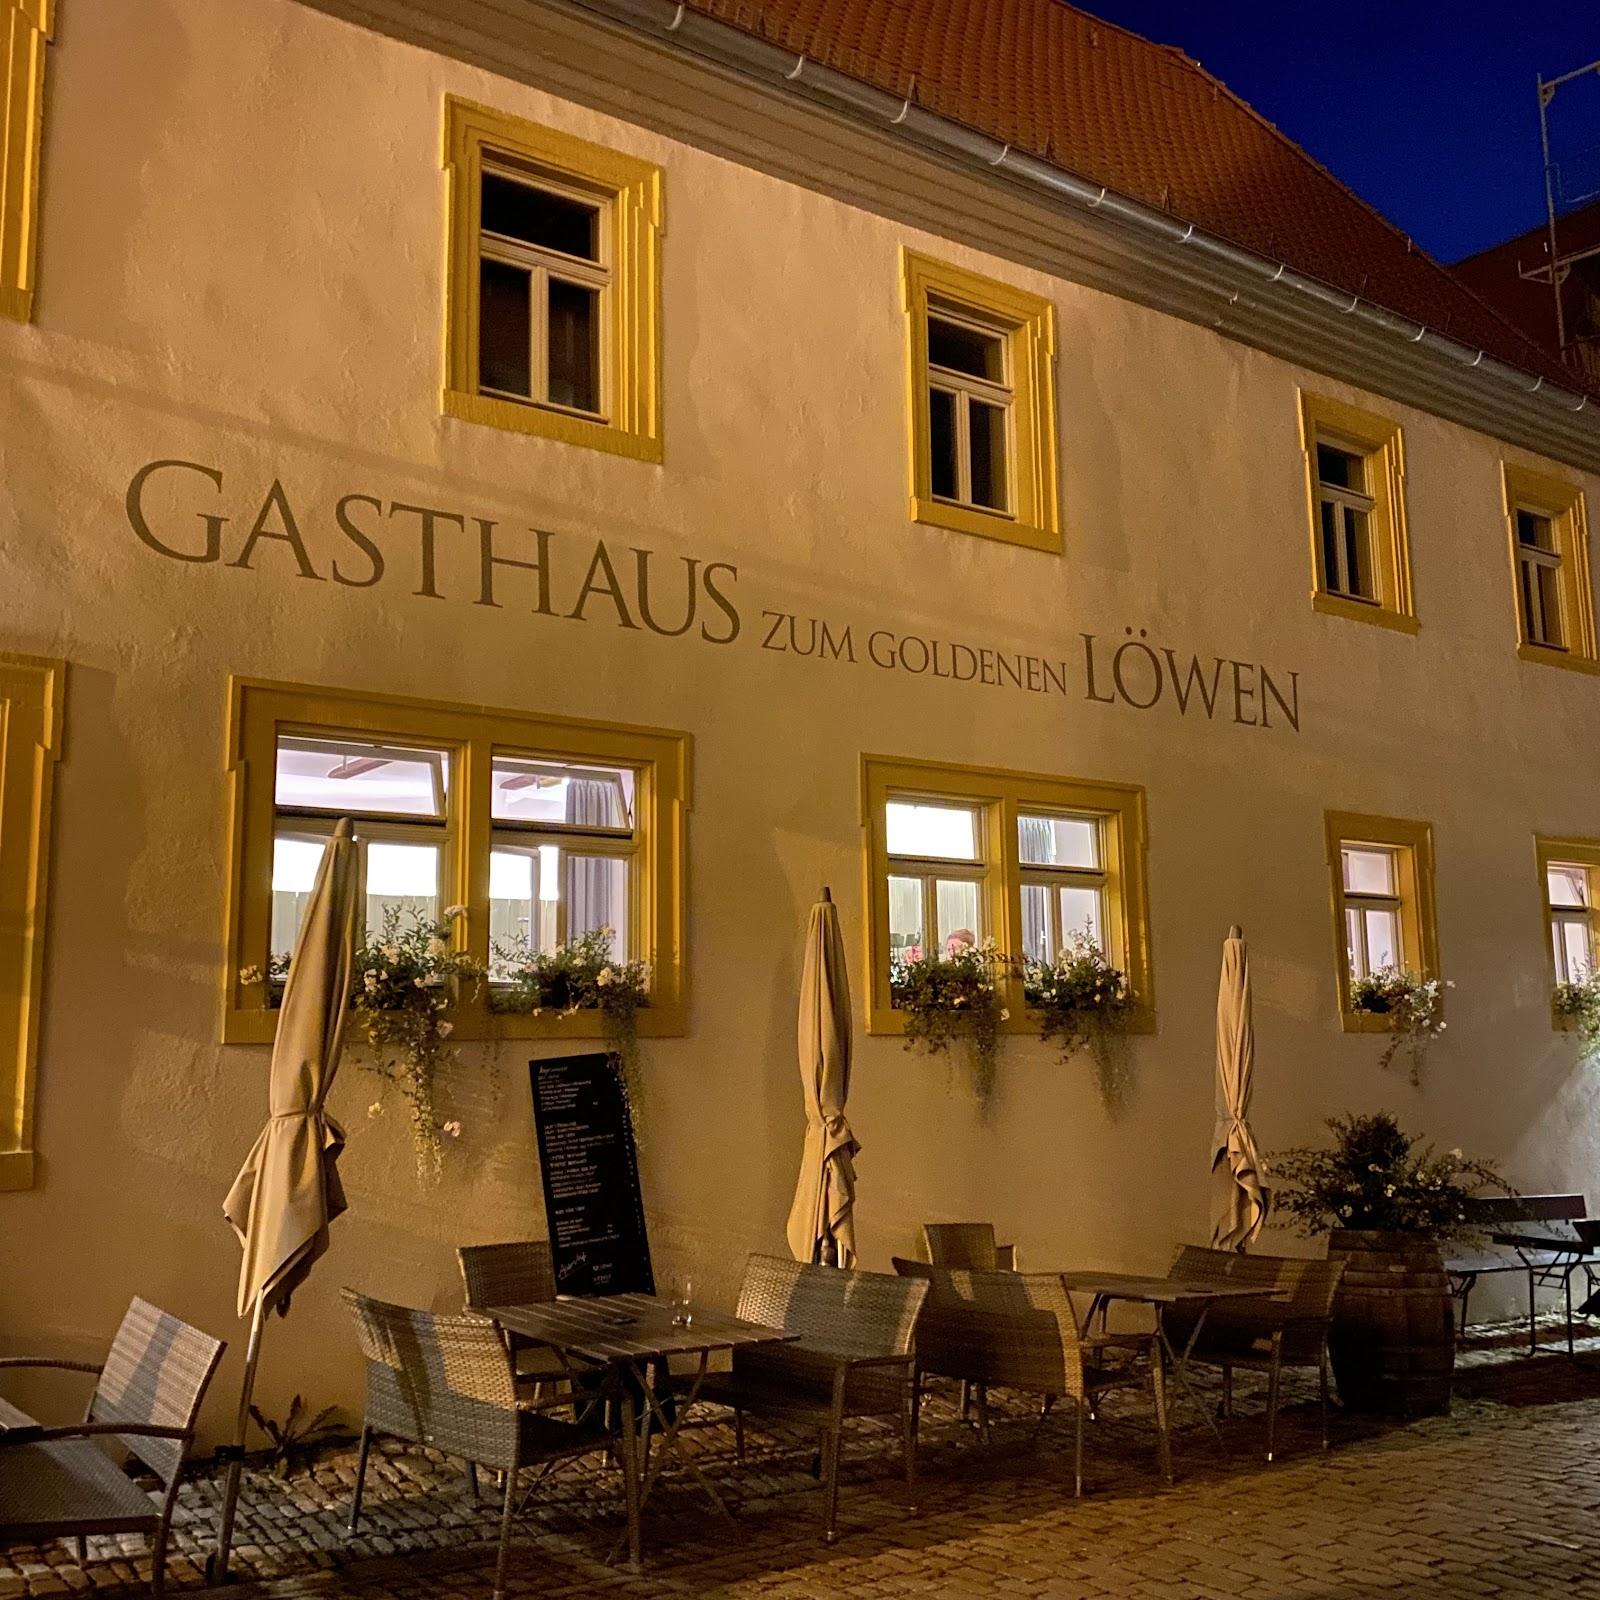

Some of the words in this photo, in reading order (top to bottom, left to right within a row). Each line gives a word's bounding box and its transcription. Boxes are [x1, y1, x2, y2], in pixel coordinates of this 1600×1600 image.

[126, 459, 741, 644] GASTHAUS
[761, 610, 858, 664] ZUM
[868, 631, 1067, 696] GOLDENEN
[1079, 626, 1300, 732] LÖWEN
